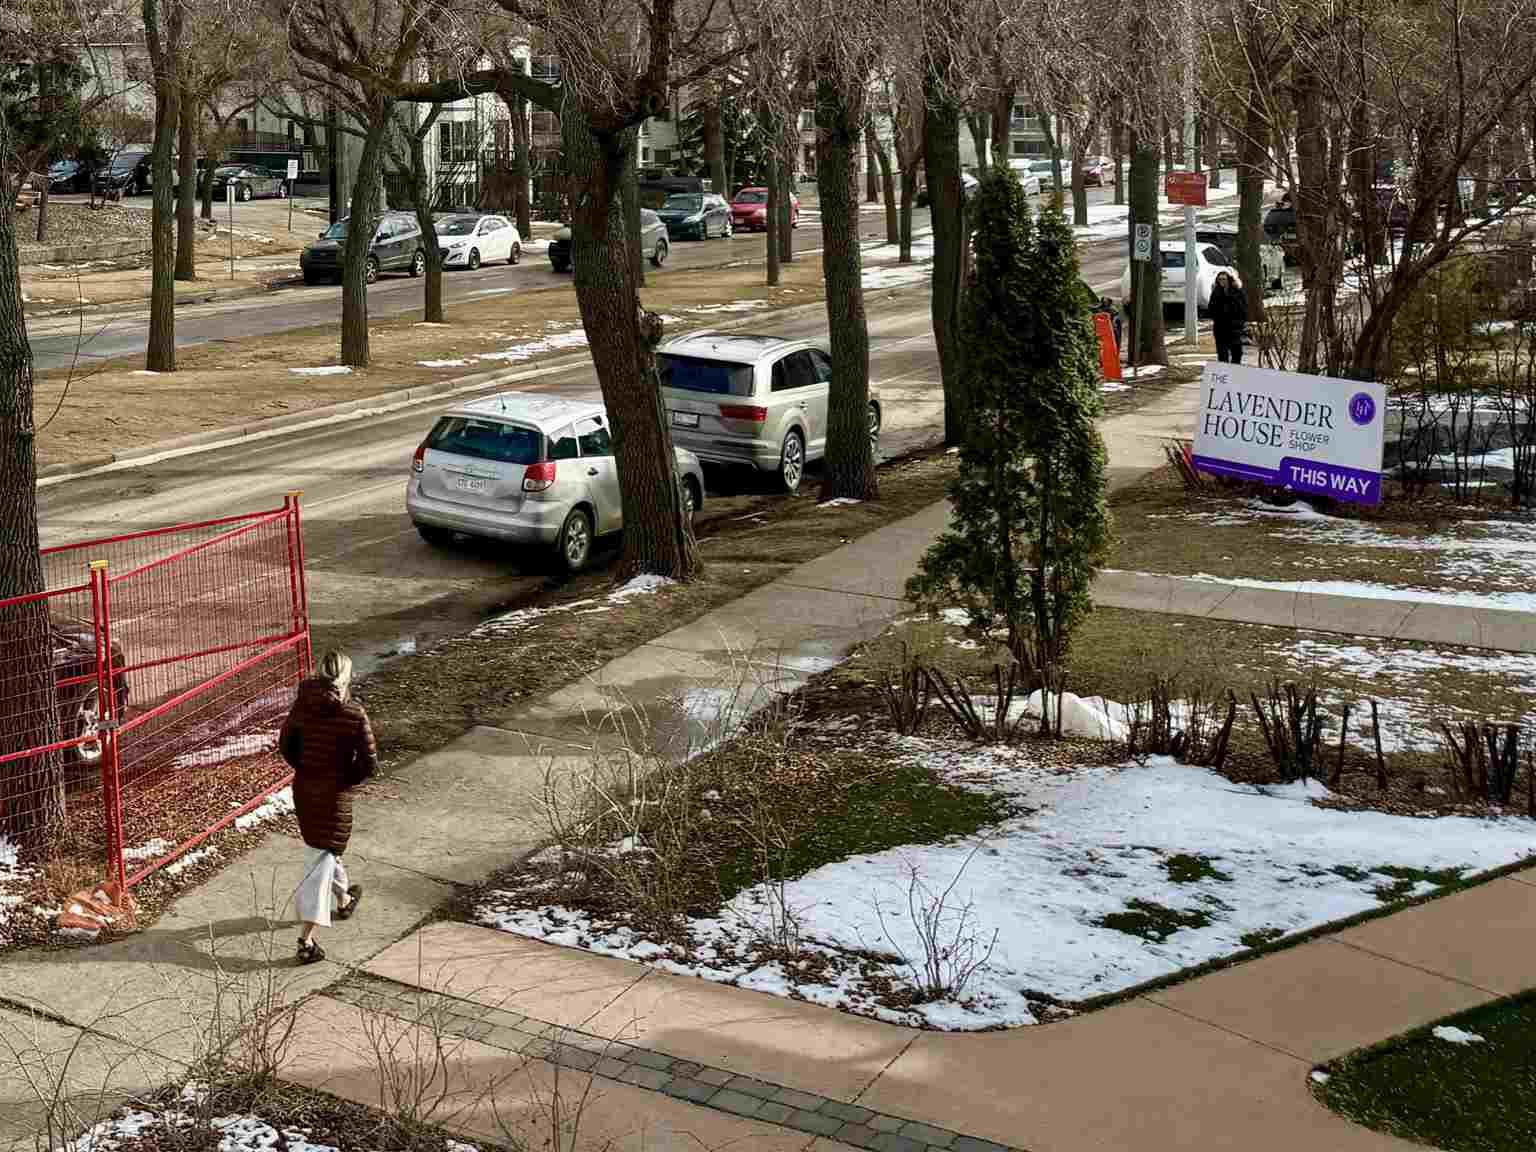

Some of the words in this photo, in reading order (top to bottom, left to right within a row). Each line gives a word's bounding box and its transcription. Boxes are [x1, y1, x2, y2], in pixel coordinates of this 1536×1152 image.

[1210, 373, 1228, 384] THE
[1207, 388, 1334, 429] LAVENDER
[1204, 413, 1284, 448] HOUSE
[1289, 430, 1330, 445] FLOWER
[1288, 440, 1316, 452] SHOP
[1289, 465, 1327, 487] THIS
[1330, 472, 1371, 496] WAY
